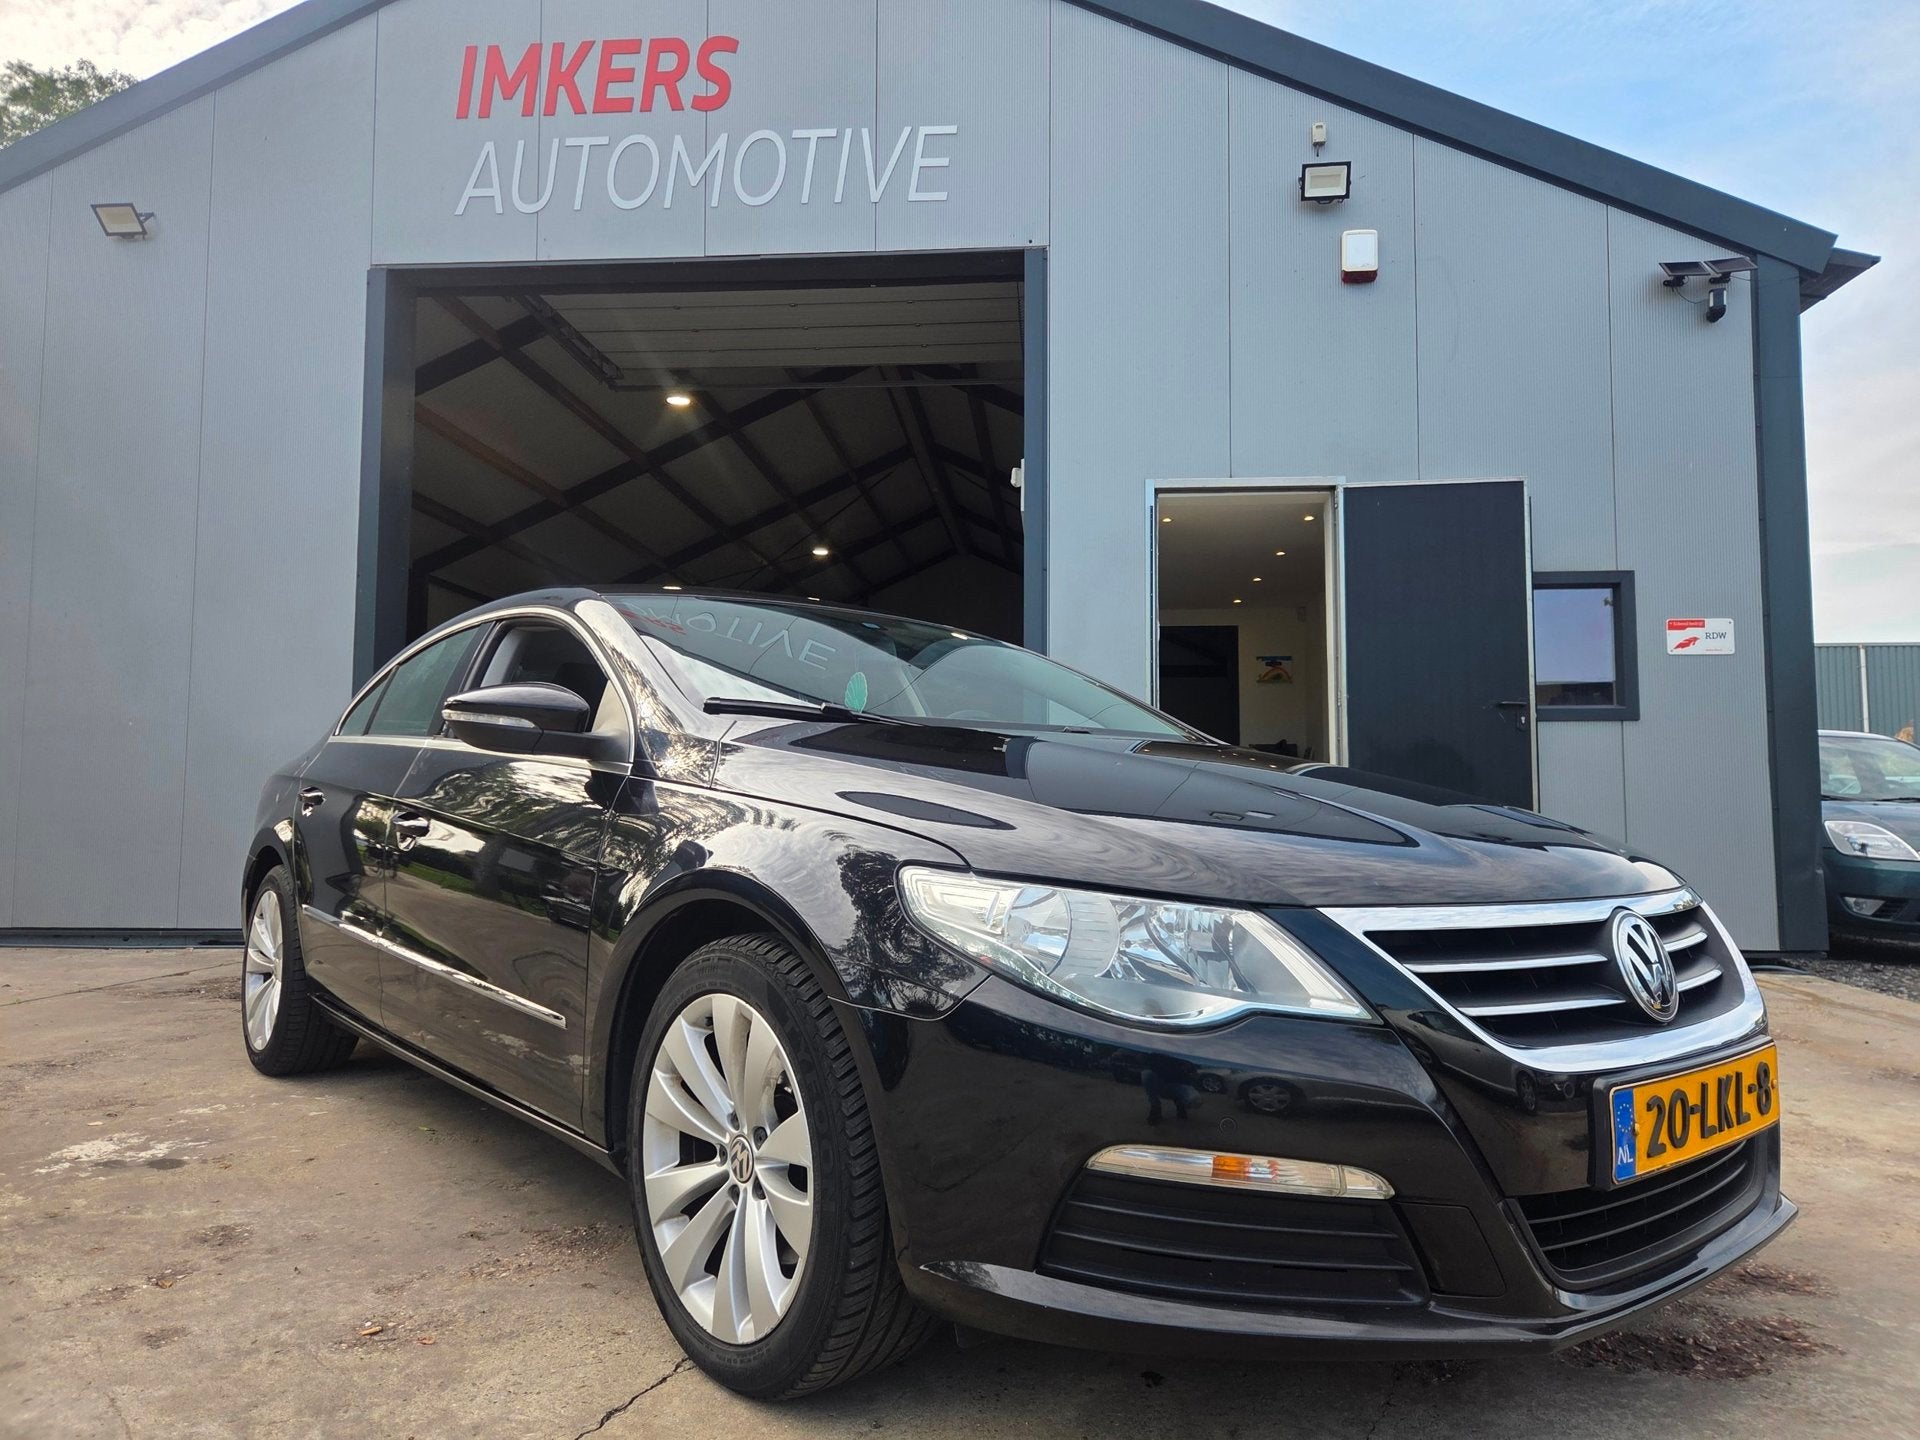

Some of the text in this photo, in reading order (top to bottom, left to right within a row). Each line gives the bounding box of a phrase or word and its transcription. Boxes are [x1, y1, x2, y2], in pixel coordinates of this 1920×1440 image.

[455, 35, 740, 120] IMKERS
[454, 124, 958, 216] AUTOMOTIVE
[1705, 631, 1727, 640] RDW
[1646, 1061, 1772, 1158] 20-LKL-8
[1617, 1144, 1633, 1165] NL
